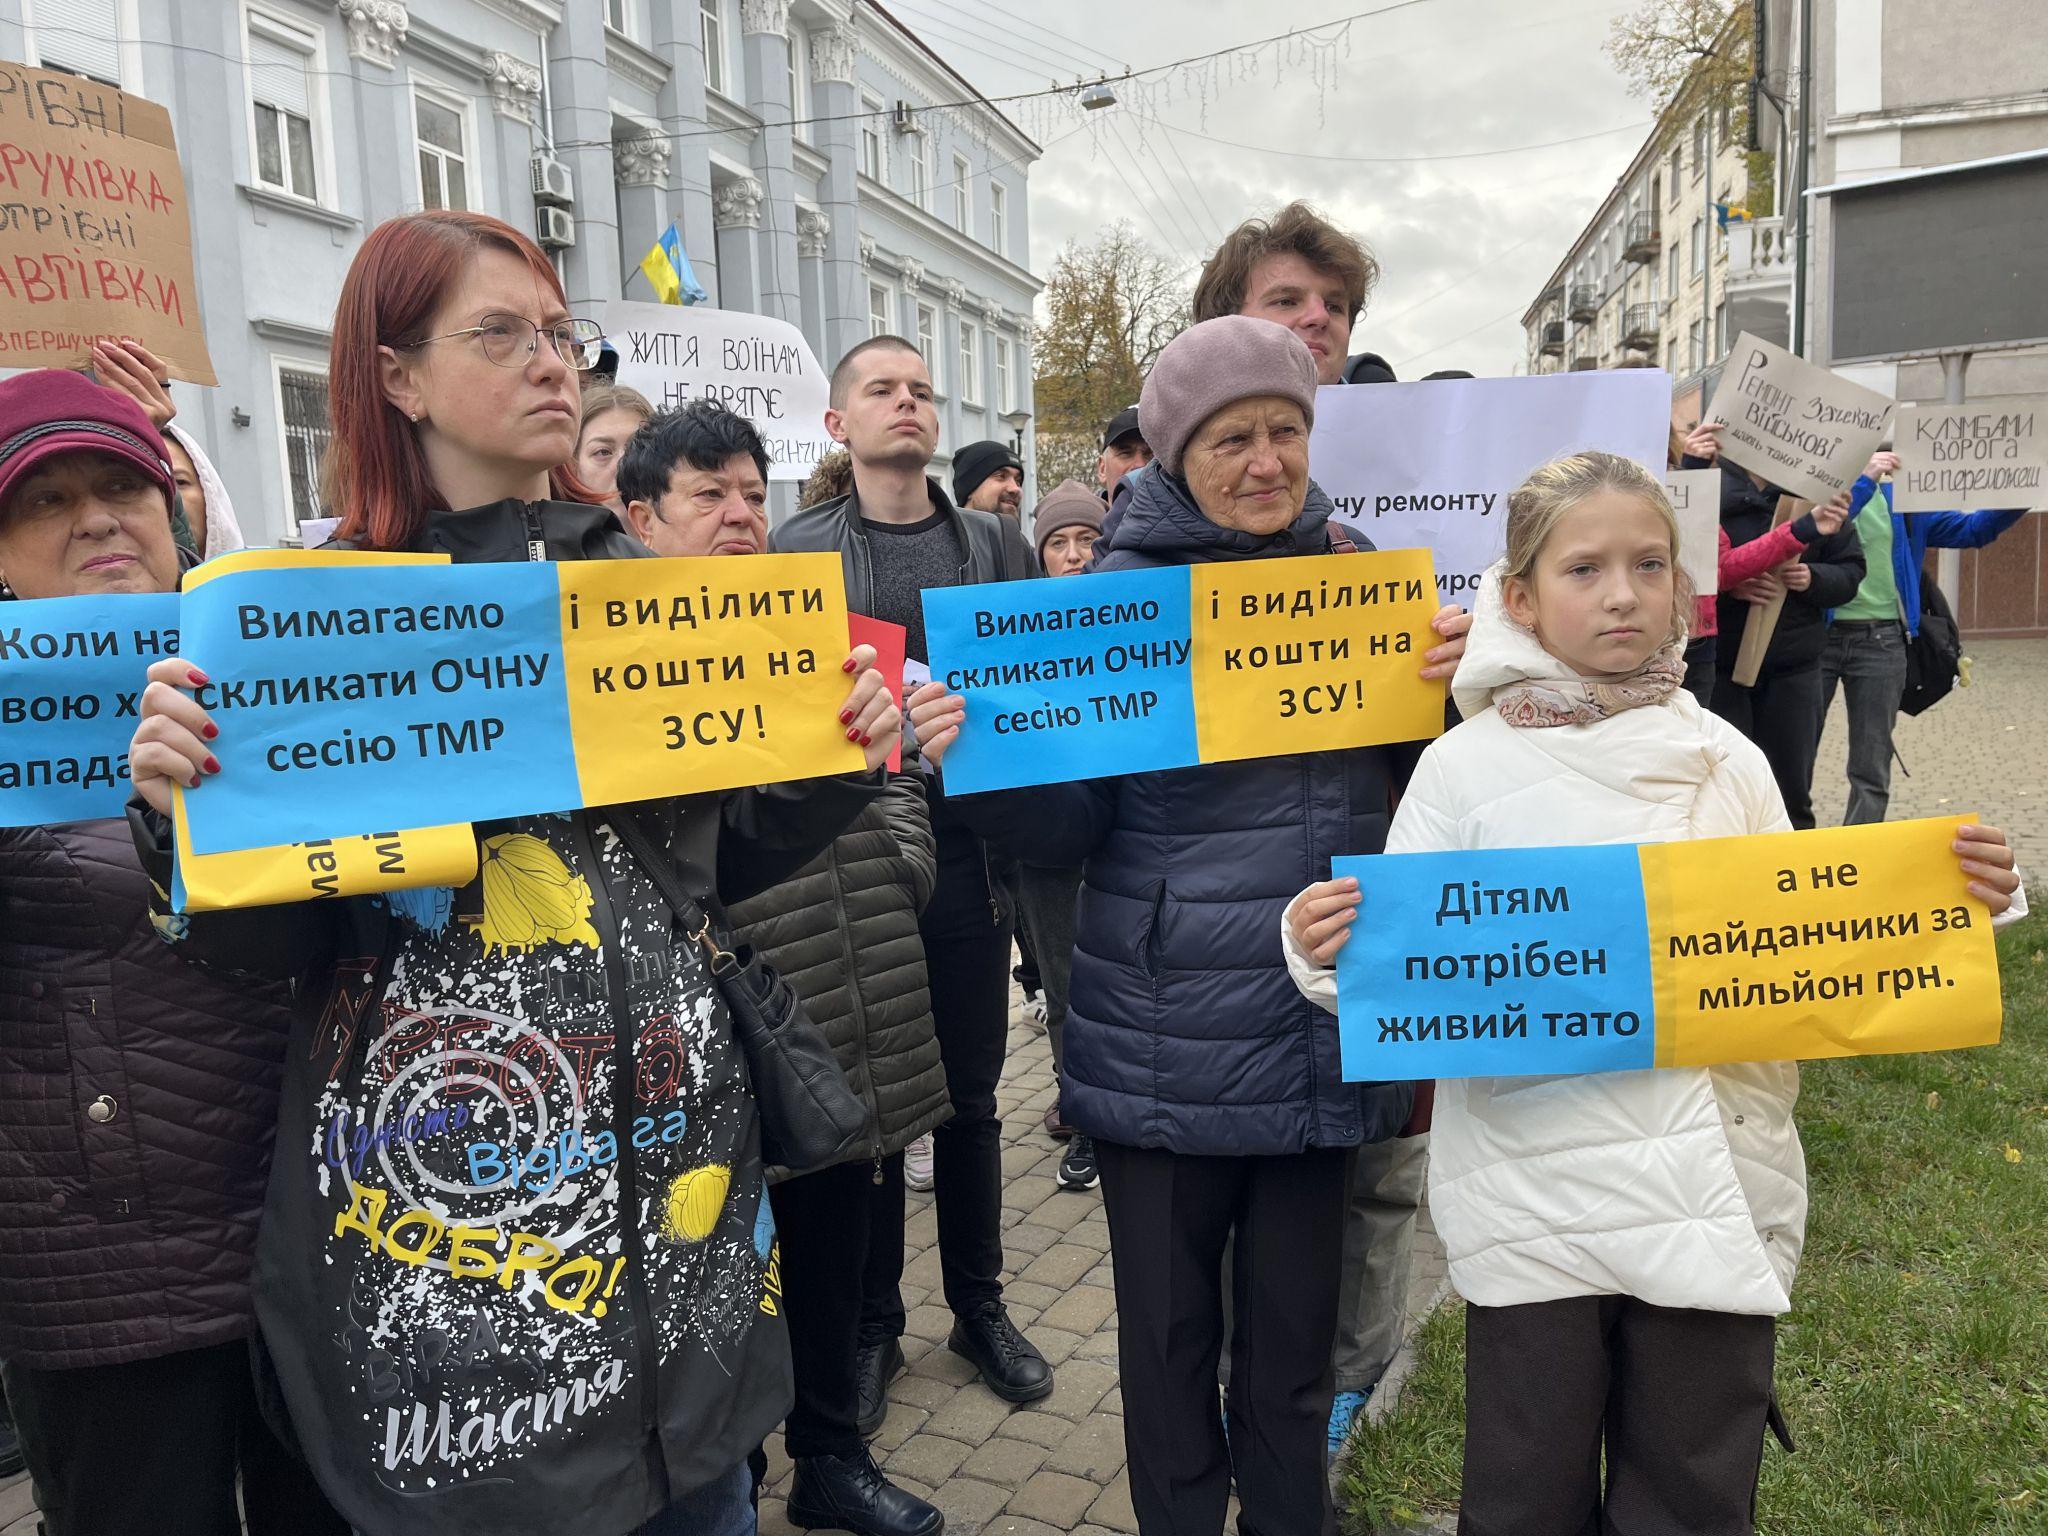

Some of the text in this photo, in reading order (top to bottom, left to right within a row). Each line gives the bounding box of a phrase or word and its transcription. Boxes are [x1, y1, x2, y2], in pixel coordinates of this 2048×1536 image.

[0, 143, 175, 216] РУКІВКА
[627, 330, 802, 375] ЖИТТЯ ВОЇНАМ
[1916, 413, 2034, 440] КЛУМБАМИ
[1375, 493, 1497, 518] ремонту
[238, 602, 504, 640] Вимагаємо
[570, 585, 823, 631] і виділити
[975, 599, 1159, 638] Вимагаємо
[1212, 578, 1422, 620] і виділити
[0, 627, 119, 660] Коли
[946, 637, 1192, 691] скликати ОЧНУ
[1224, 631, 1411, 671] кошти на
[192, 653, 549, 711] скликати ОЧНУ
[592, 649, 816, 694] кошти на
[2, 694, 100, 724] вою
[993, 690, 1158, 735] сесію ТМР
[1279, 679, 1363, 718] ЗСУ!
[266, 718, 504, 772] сесію ТМР
[662, 704, 765, 750] ЗСУ!
[1777, 863, 1858, 894] а не
[1435, 879, 1570, 926] Дітям
[1669, 906, 1972, 958] майданчики за
[1405, 940, 1607, 987] потрібен
[1699, 965, 1954, 1010] мільйон грн.
[1377, 1002, 1640, 1043] живий тато
[335, 1181, 626, 1317] ДОБРО!
[382, 1359, 627, 1471] Щастя
